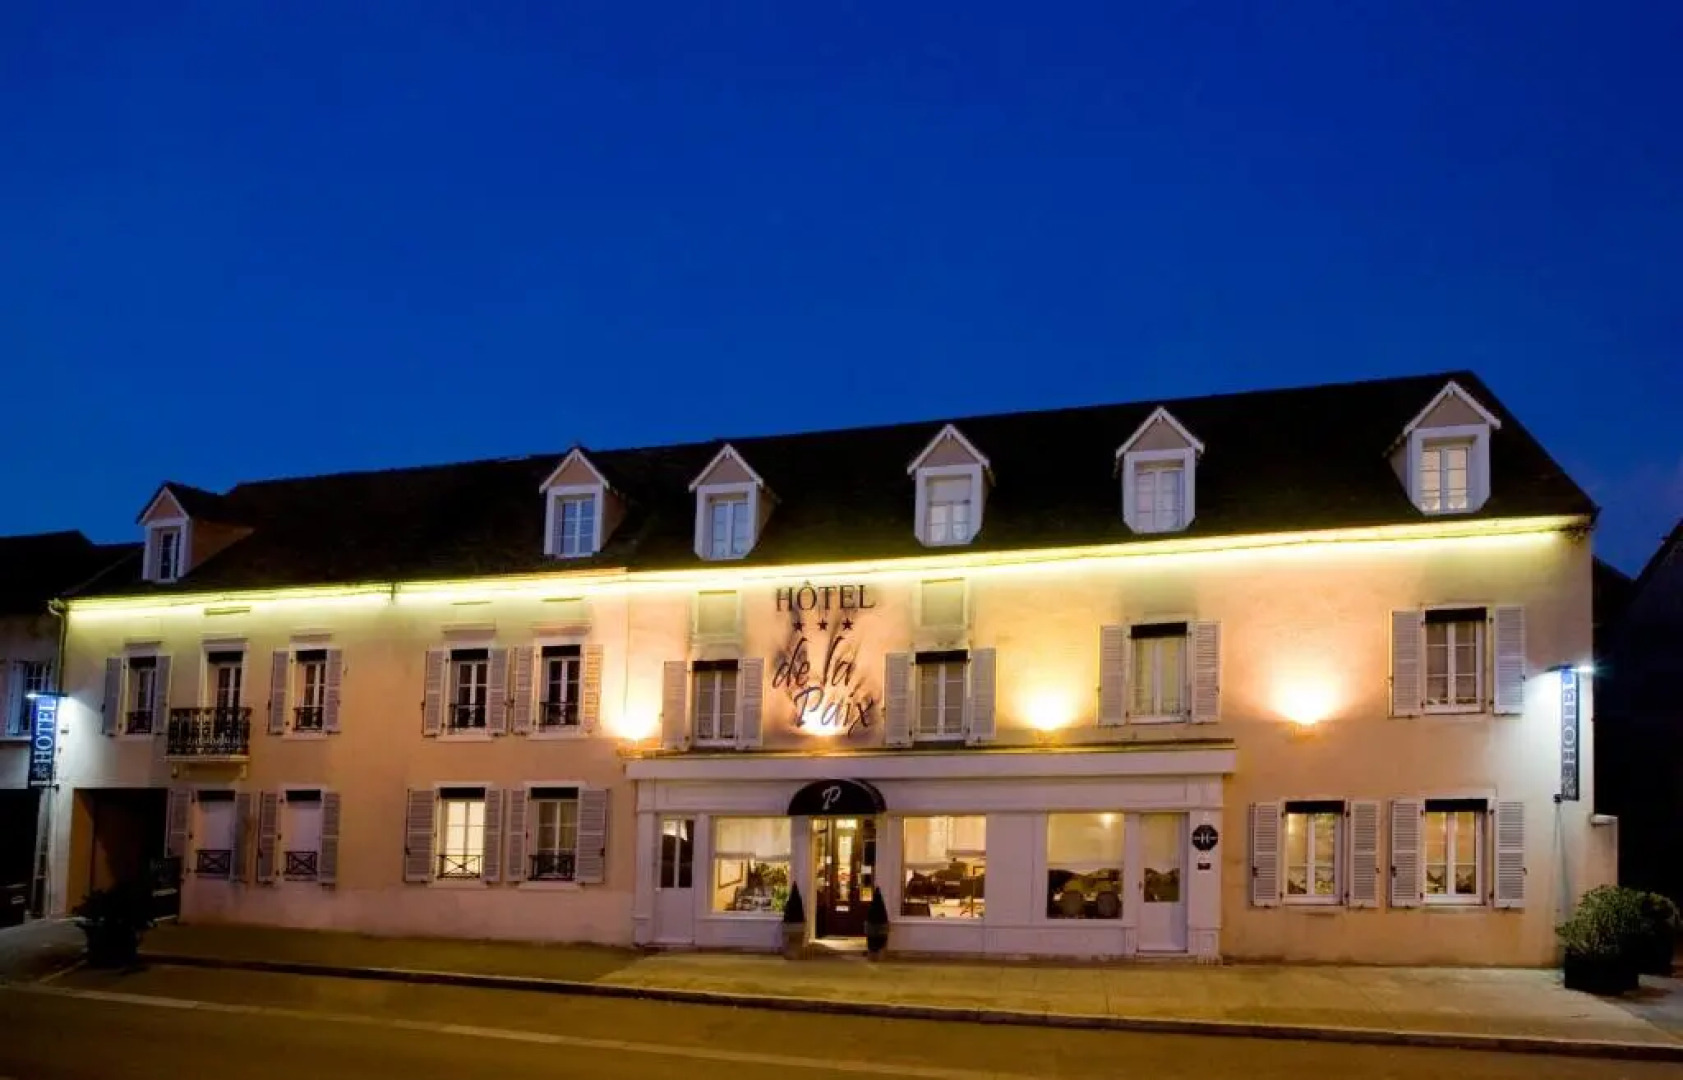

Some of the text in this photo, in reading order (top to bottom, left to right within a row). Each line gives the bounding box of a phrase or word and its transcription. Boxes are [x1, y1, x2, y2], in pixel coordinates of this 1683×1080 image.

[776, 580, 876, 611] HÔTEL
[772, 636, 853, 688] de la
[34, 699, 56, 764] HOTEL
[794, 680, 875, 738] Paix
[1562, 672, 1576, 764] HOTEL
[822, 785, 842, 810] P
